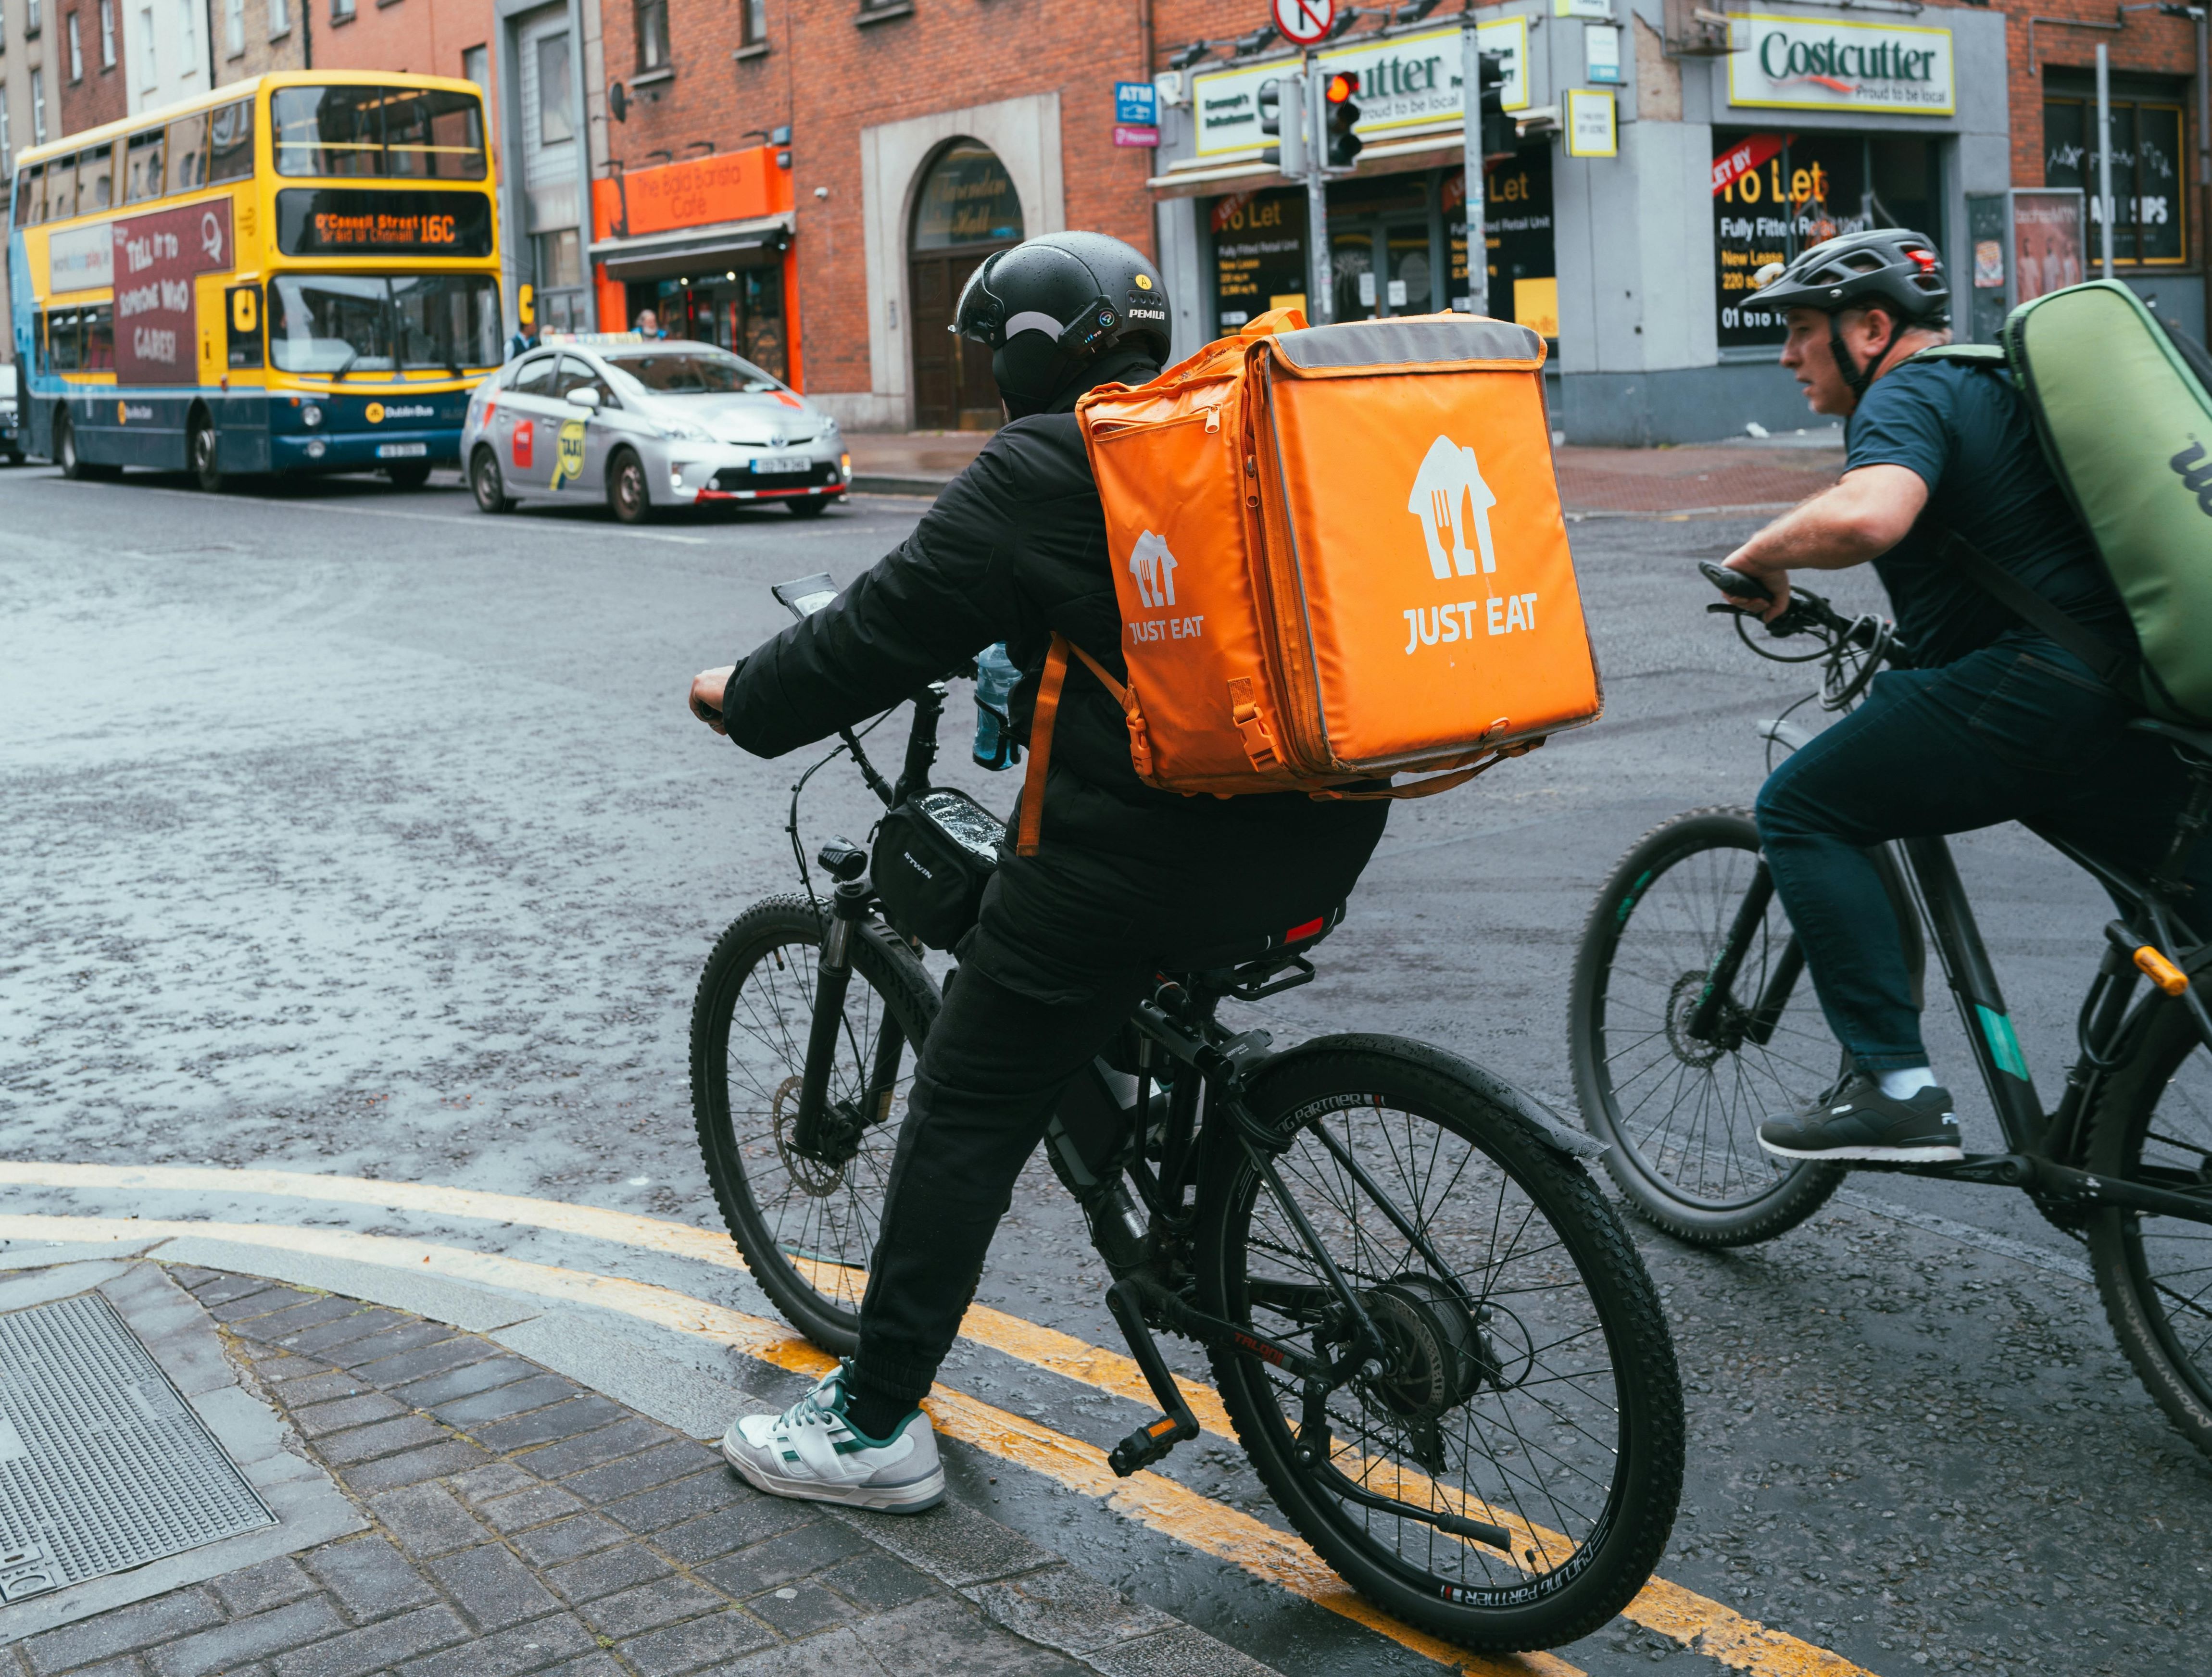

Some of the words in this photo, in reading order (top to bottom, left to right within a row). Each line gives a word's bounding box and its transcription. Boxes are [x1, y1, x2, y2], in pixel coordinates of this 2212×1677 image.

[1760, 31, 1936, 81] Costcutter
[1119, 85, 1153, 103] ATM
[1361, 103, 1391, 119] roud
[1395, 102, 1408, 115] to
[1410, 98, 1425, 113] be
[1428, 93, 1459, 109] local
[1856, 84, 1889, 100] Proud
[1892, 87, 1902, 101] to
[1905, 86, 1918, 102] be
[1921, 87, 1946, 103] local
[1732, 146, 1751, 174] BY
[1489, 171, 1529, 204] Let
[1771, 158, 1824, 203] Let
[420, 214, 455, 243] 16C
[1248, 201, 1282, 229] Let
[1501, 218, 1529, 232] Retail
[1530, 216, 1550, 229] Unit
[1720, 216, 1754, 241] Fully
[1722, 250, 1748, 266] New
[1750, 249, 1785, 266] Lease
[1722, 272, 1744, 290] 220
[1129, 309, 1165, 320] PEMILA
[1722, 307, 1740, 329] 01
[1129, 620, 1166, 645] JUST
[1170, 615, 1204, 639] EAT
[1403, 601, 1477, 655] JUST
[1486, 592, 1538, 636] EAT
[904, 851, 932, 879] BTWIN
